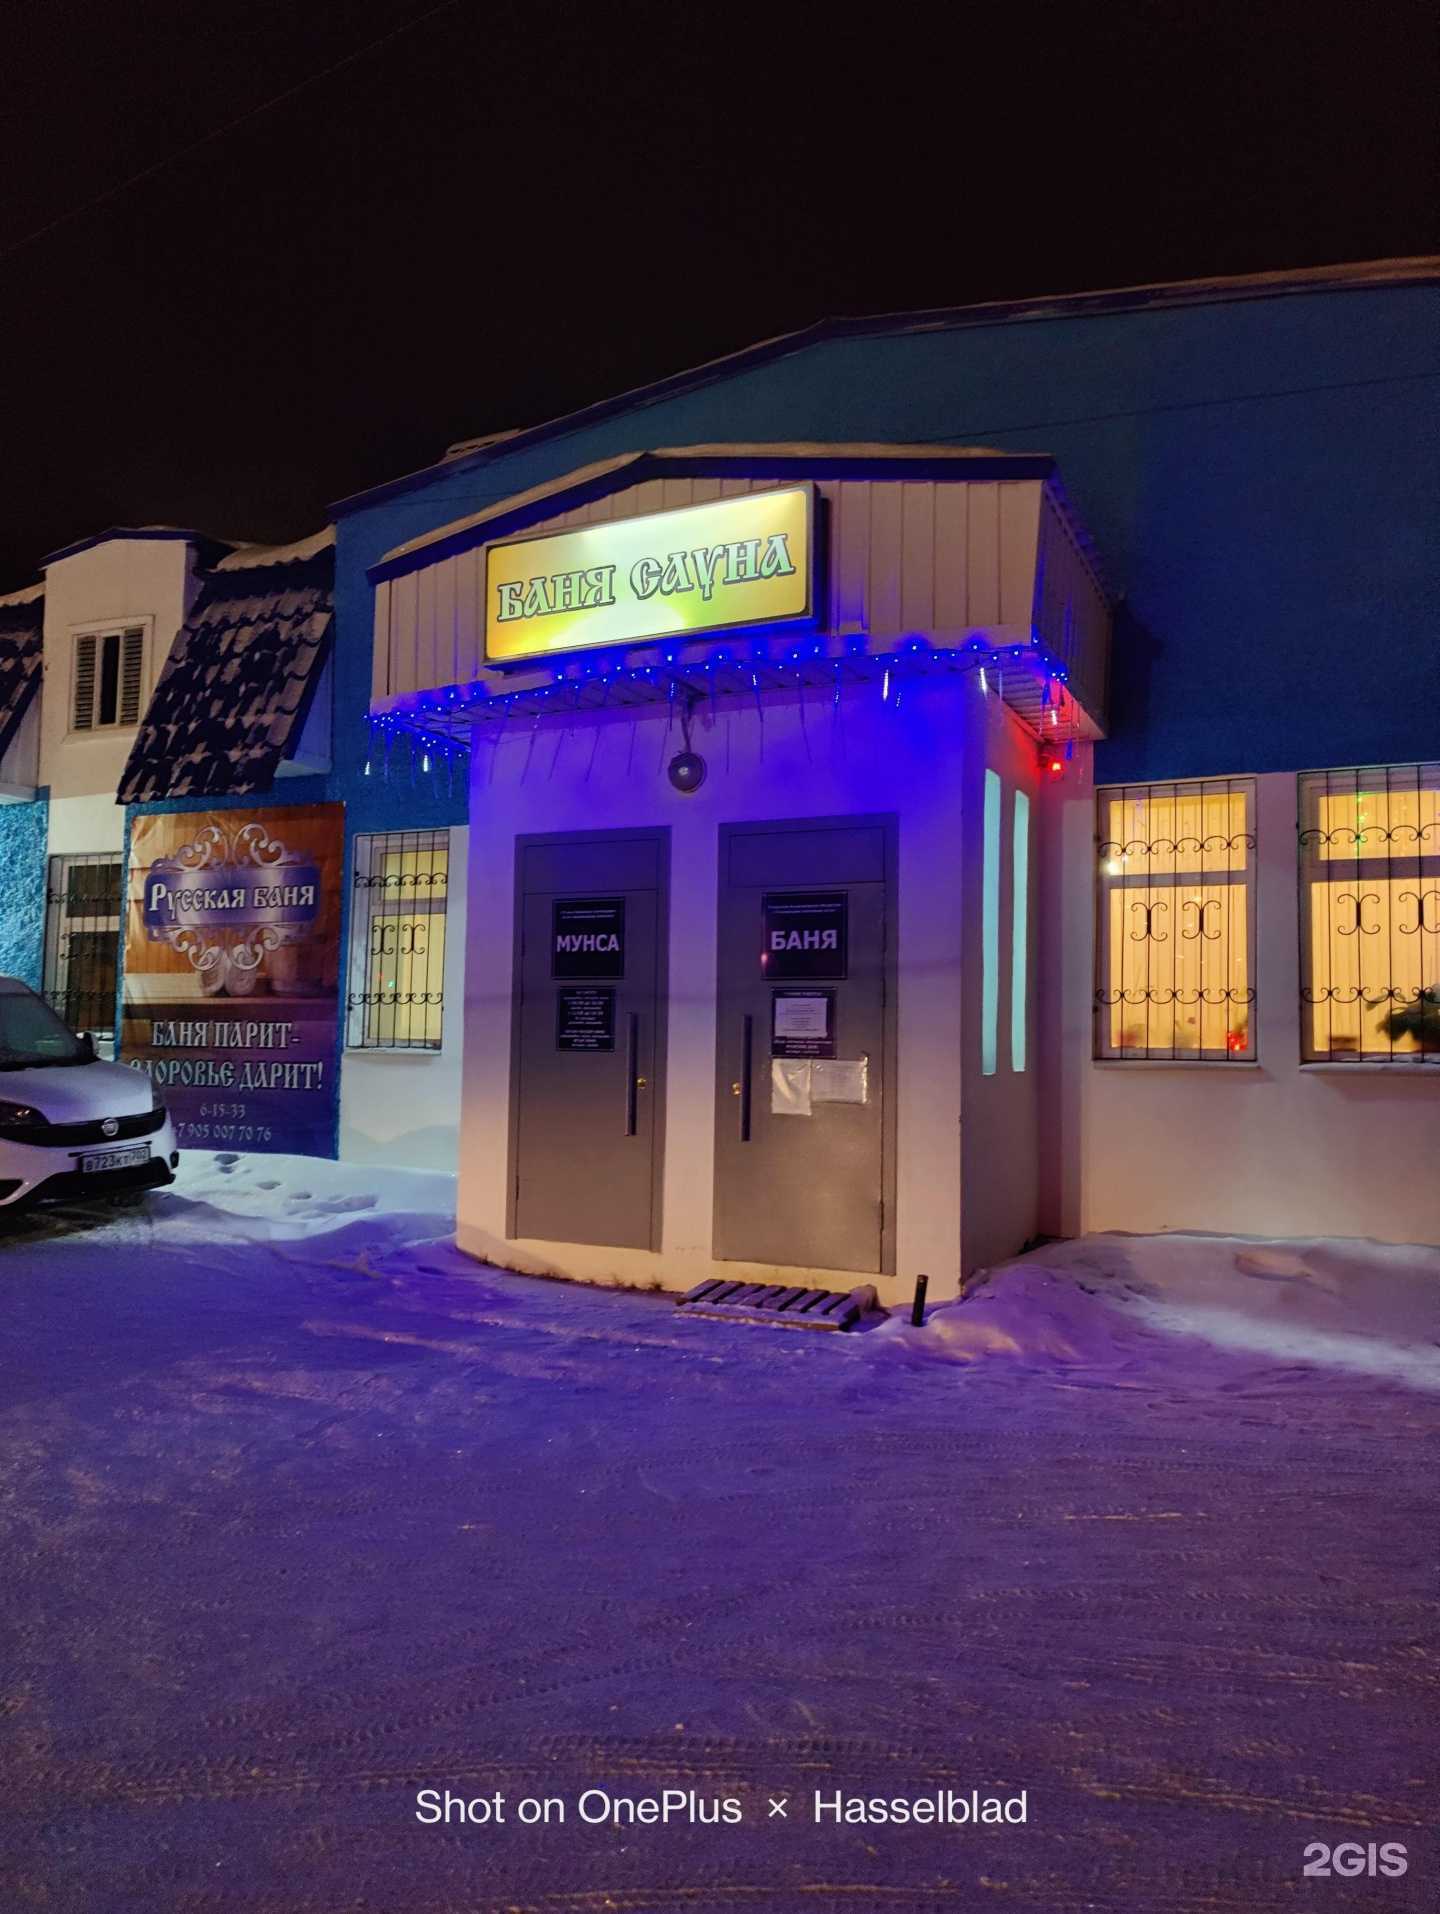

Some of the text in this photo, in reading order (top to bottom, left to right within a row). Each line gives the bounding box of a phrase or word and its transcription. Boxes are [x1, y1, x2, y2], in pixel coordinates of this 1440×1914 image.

[497, 533, 796, 622] БАНЯ САУНА
[148, 882, 245, 920] Русская
[556, 933, 620, 953] МУНСА
[770, 929, 838, 951] БАНЯ
[151, 1020, 209, 1047] БАНЯ
[238, 1061, 324, 1091] ДАРИТ!
